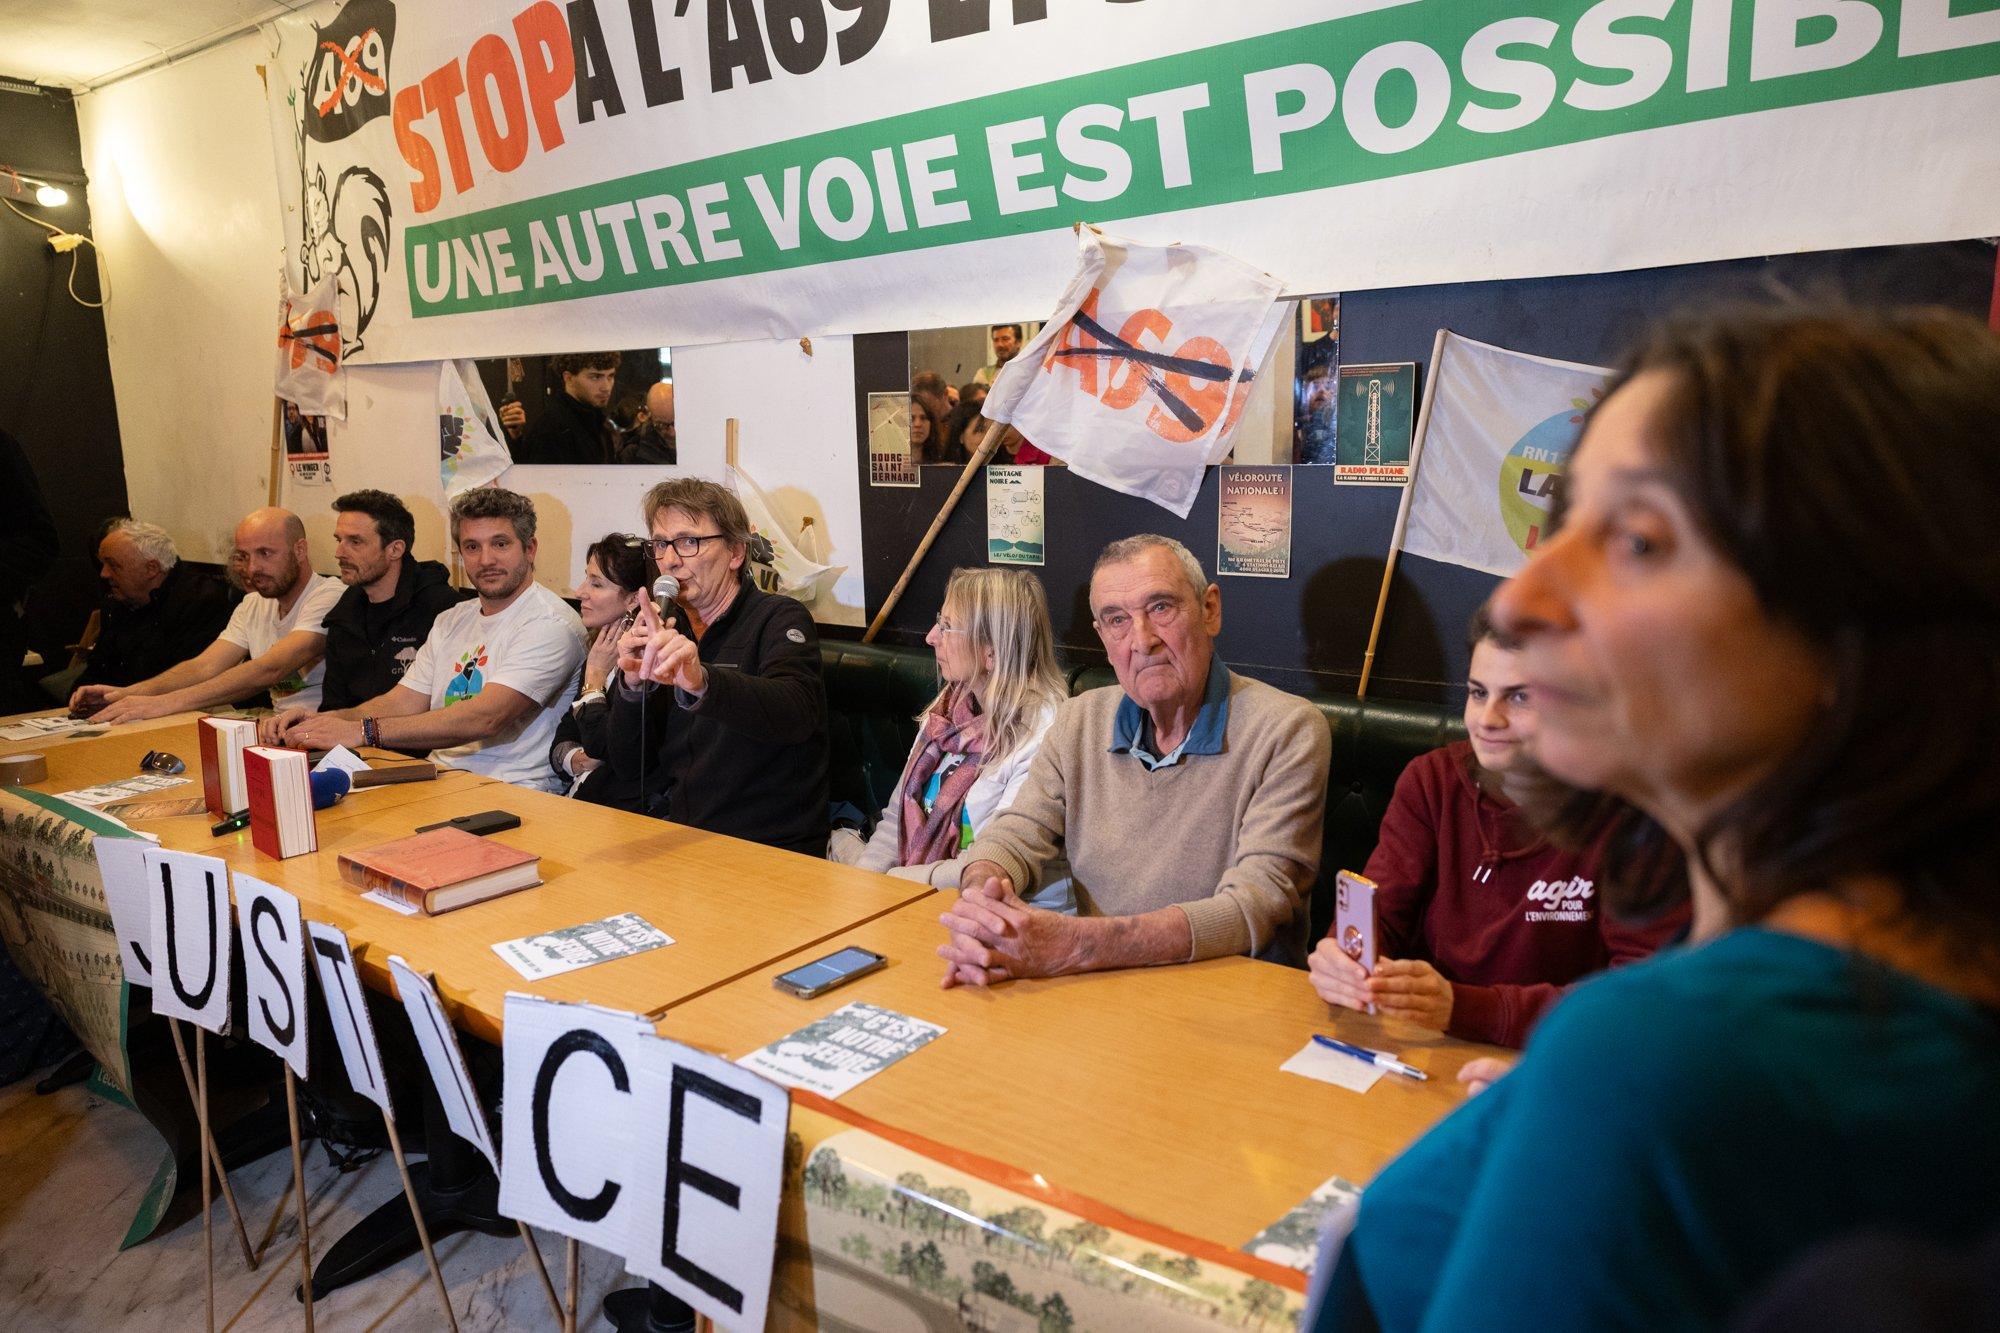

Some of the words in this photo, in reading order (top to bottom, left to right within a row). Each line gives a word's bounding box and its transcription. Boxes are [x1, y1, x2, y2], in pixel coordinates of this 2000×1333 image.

[394, 0, 576, 213] STOP
[574, 0, 626, 124] A
[413, 228, 524, 304] UNE
[534, 175, 744, 288] AUTRE
[744, 133, 971, 252] VOIE
[985, 82, 1211, 216] EST
[872, 453, 902, 462] BOURG
[872, 463, 902, 472] SAINT
[1369, 467, 1404, 475] PLATANE
[872, 472, 916, 482] BERNARD
[1229, 472, 1283, 482] VÉLOROUTE
[1227, 486, 1278, 495] NATIONALE
[1527, 875, 1595, 910] agir
[1561, 900, 1583, 910] POUR
[1525, 911, 1592, 922] L'ENVIRONNEME
[863, 1014, 930, 1042] C'EST
[827, 1025, 906, 1059] NOTRE
[811, 1041, 881, 1074] TERRE
